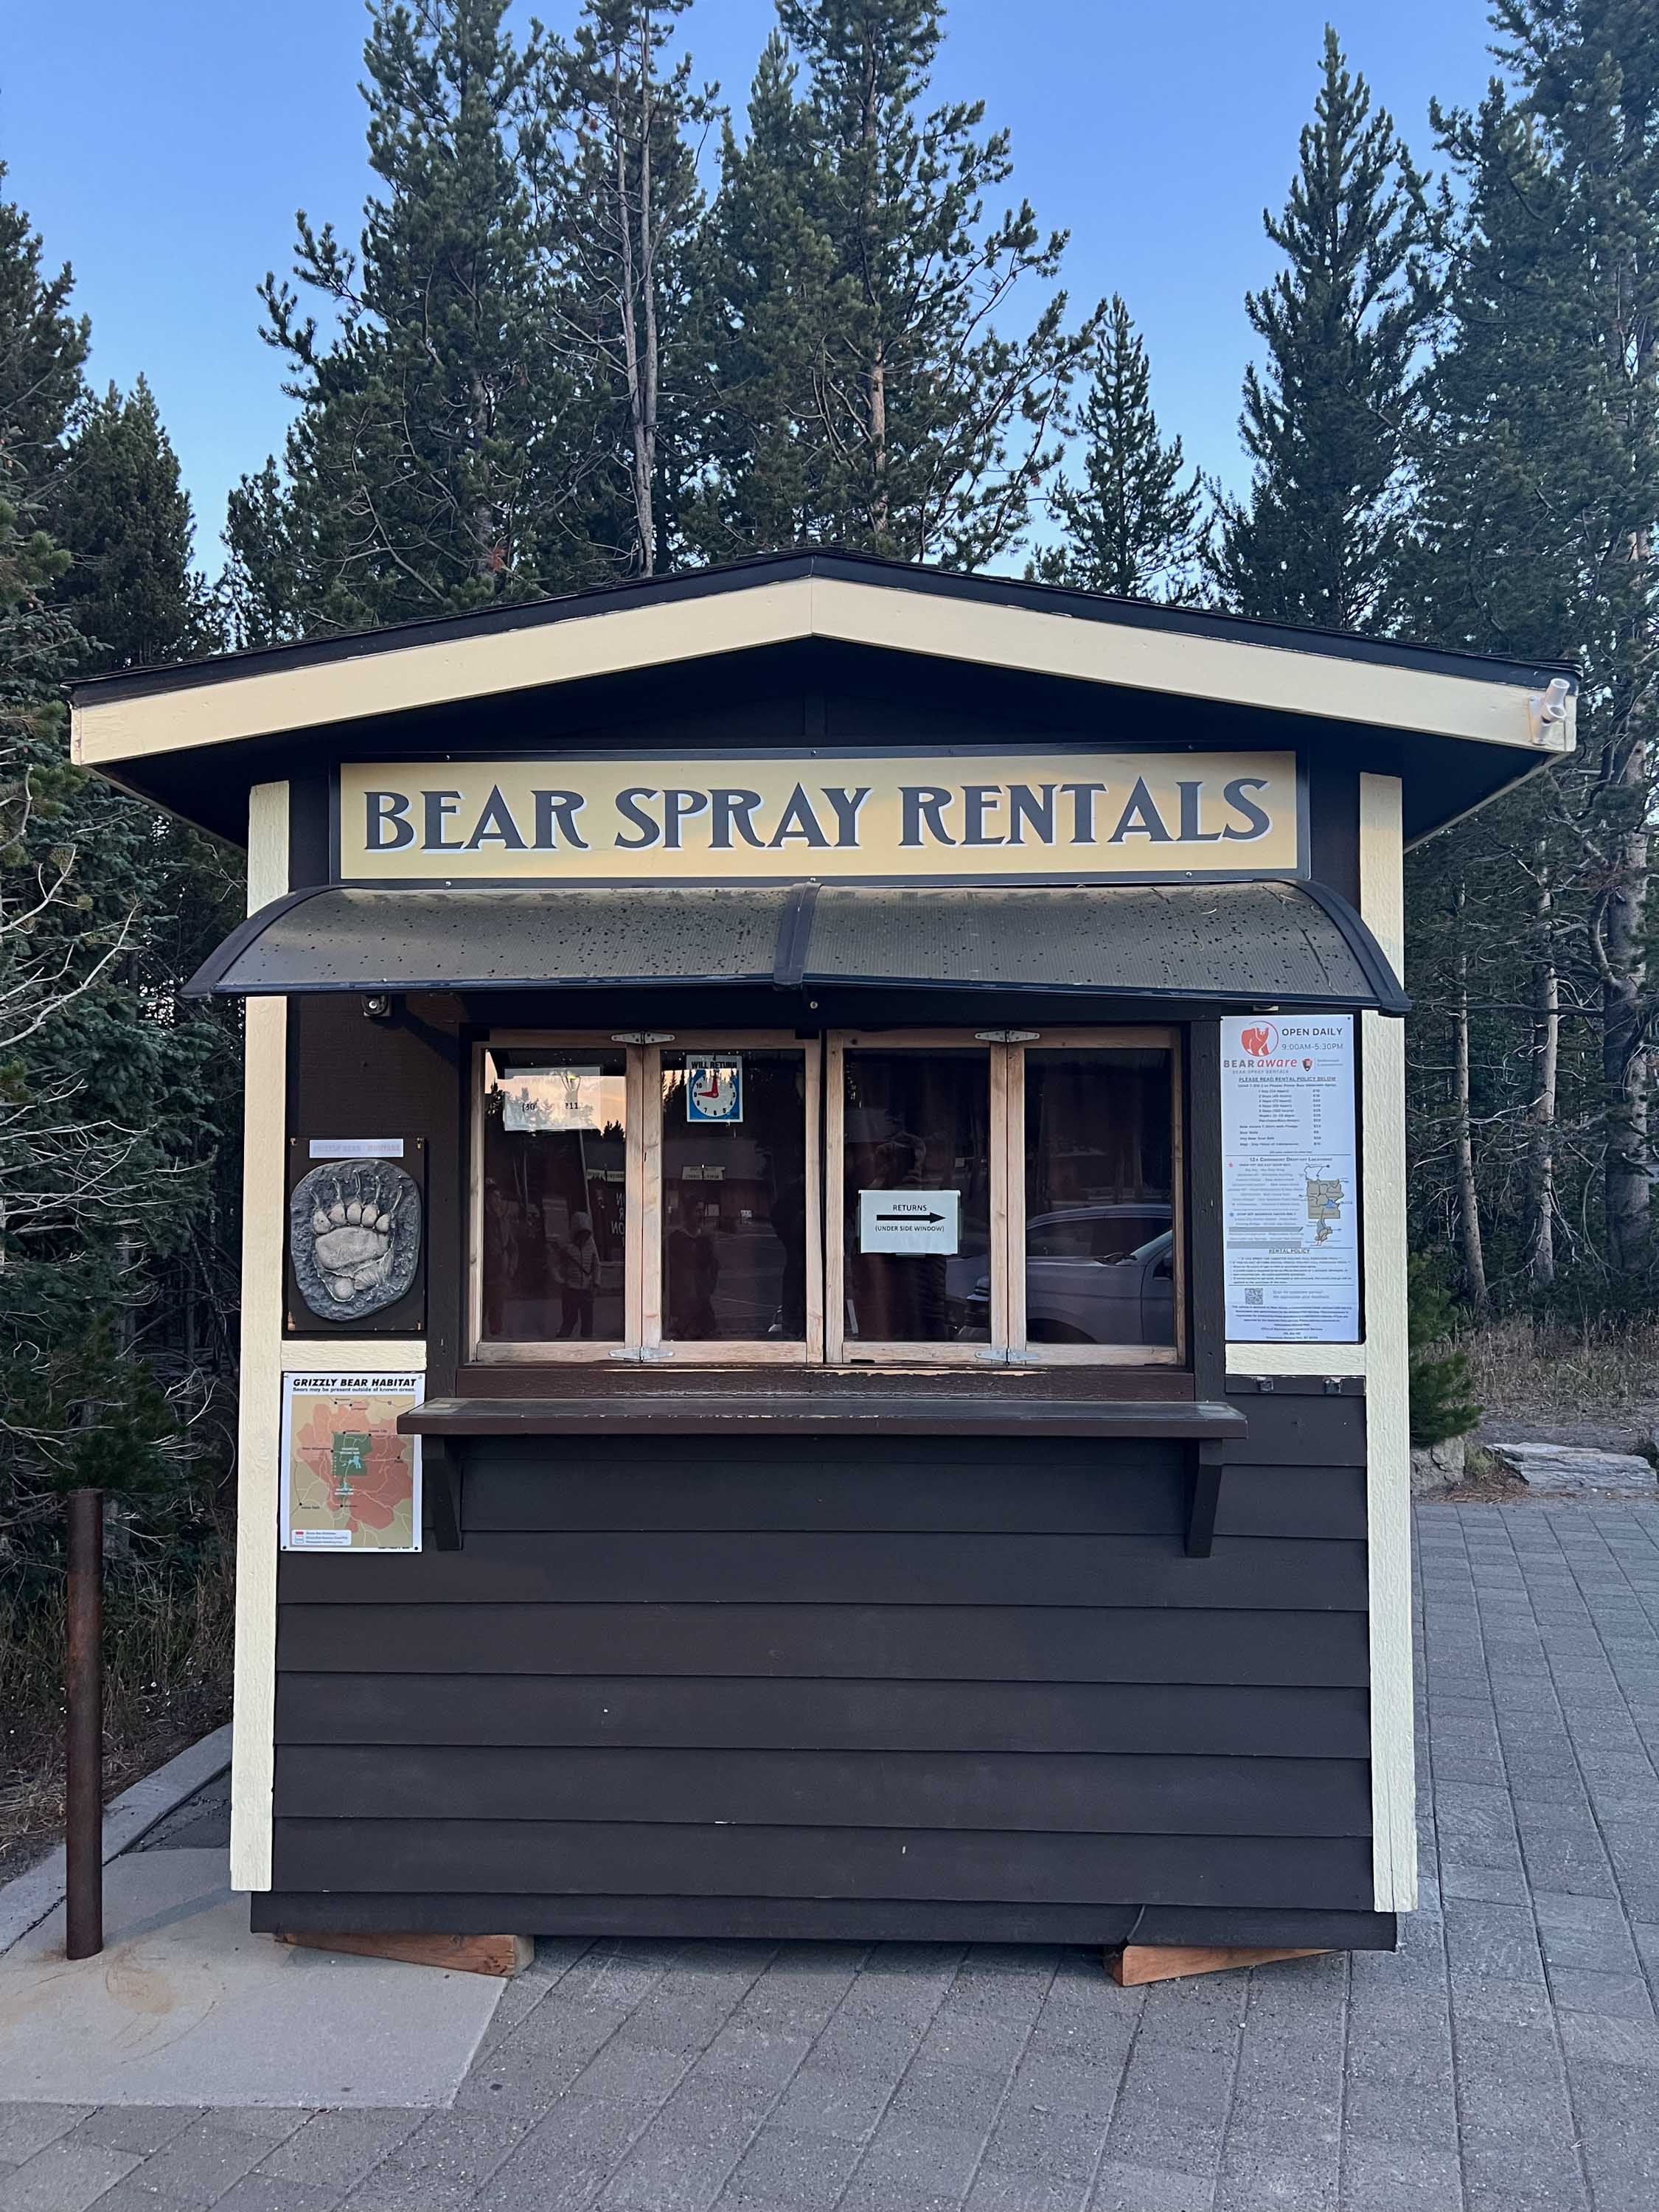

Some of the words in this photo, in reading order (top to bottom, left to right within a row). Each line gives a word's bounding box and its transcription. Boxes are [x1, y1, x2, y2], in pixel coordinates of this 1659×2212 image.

[364, 784, 590, 853] BEAR
[613, 782, 873, 852] SPRAY
[897, 776, 1274, 848] RENTALS
[1281, 1028, 1310, 1036] OPEN
[1312, 1028, 1343, 1036] DAILY
[1281, 1043, 1343, 1051] 9:00AM-5:30PM
[709, 1061, 737, 1069] RETURN
[1223, 1060, 1255, 1068] BEAR
[1257, 1059, 1298, 1068] aware
